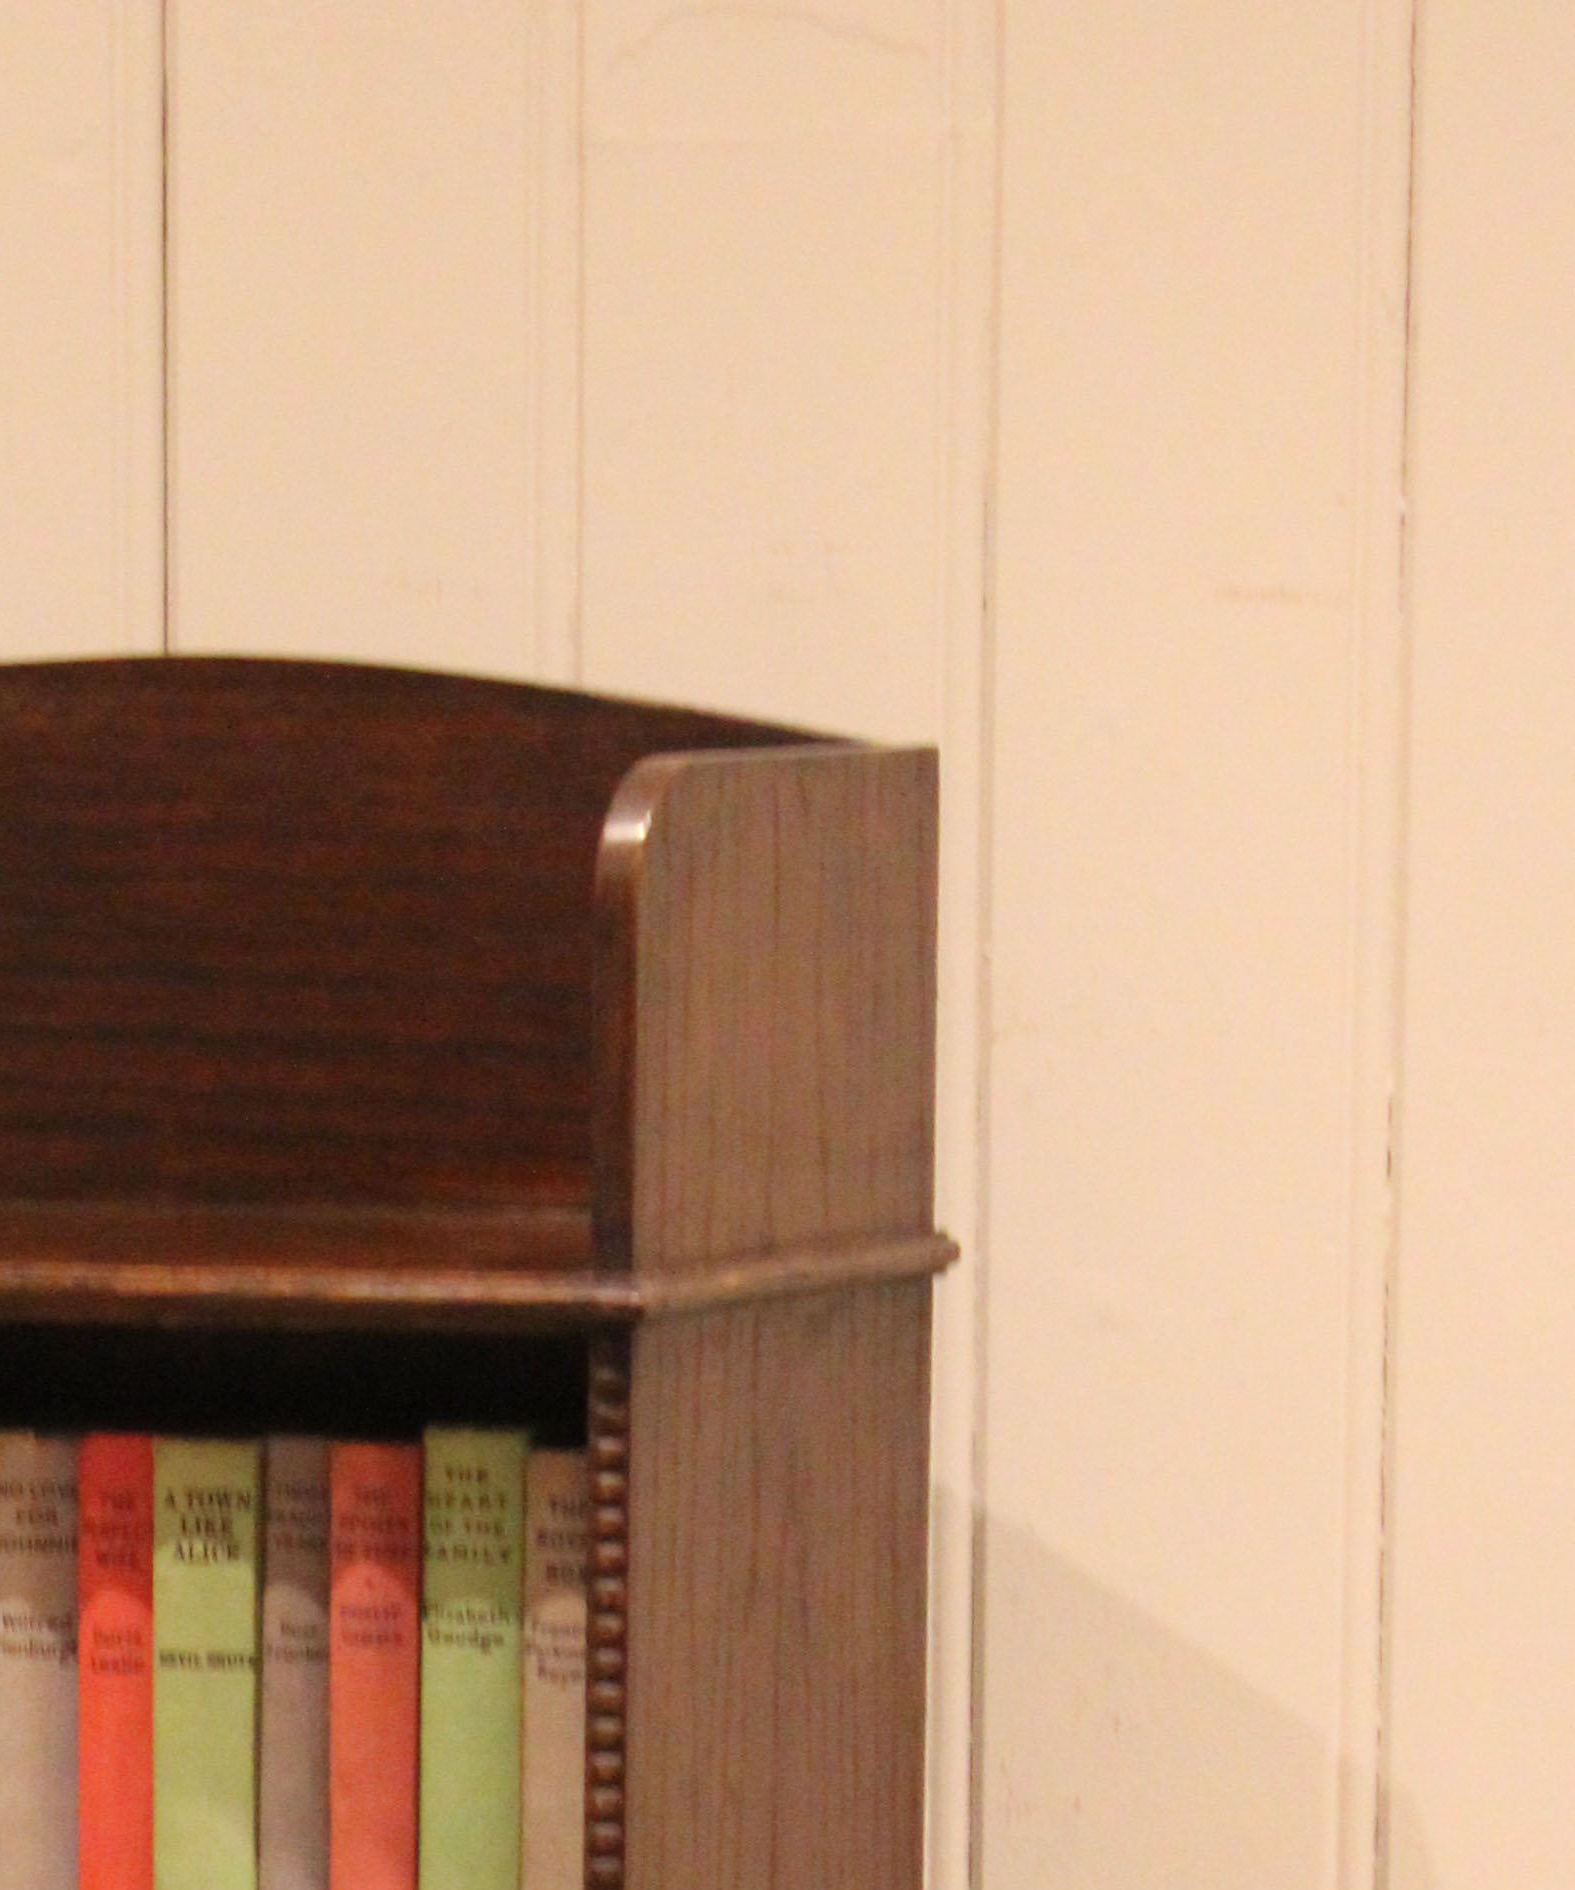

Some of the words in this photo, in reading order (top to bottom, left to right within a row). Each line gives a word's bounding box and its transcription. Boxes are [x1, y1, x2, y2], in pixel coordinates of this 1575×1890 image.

[444, 1465, 489, 1485] THE
[163, 1487, 179, 1510] A
[186, 1486, 253, 1513] TOWN
[180, 1515, 235, 1538] LIKE
[462, 1518, 506, 1538] THE
[173, 1541, 241, 1567] ALICE
